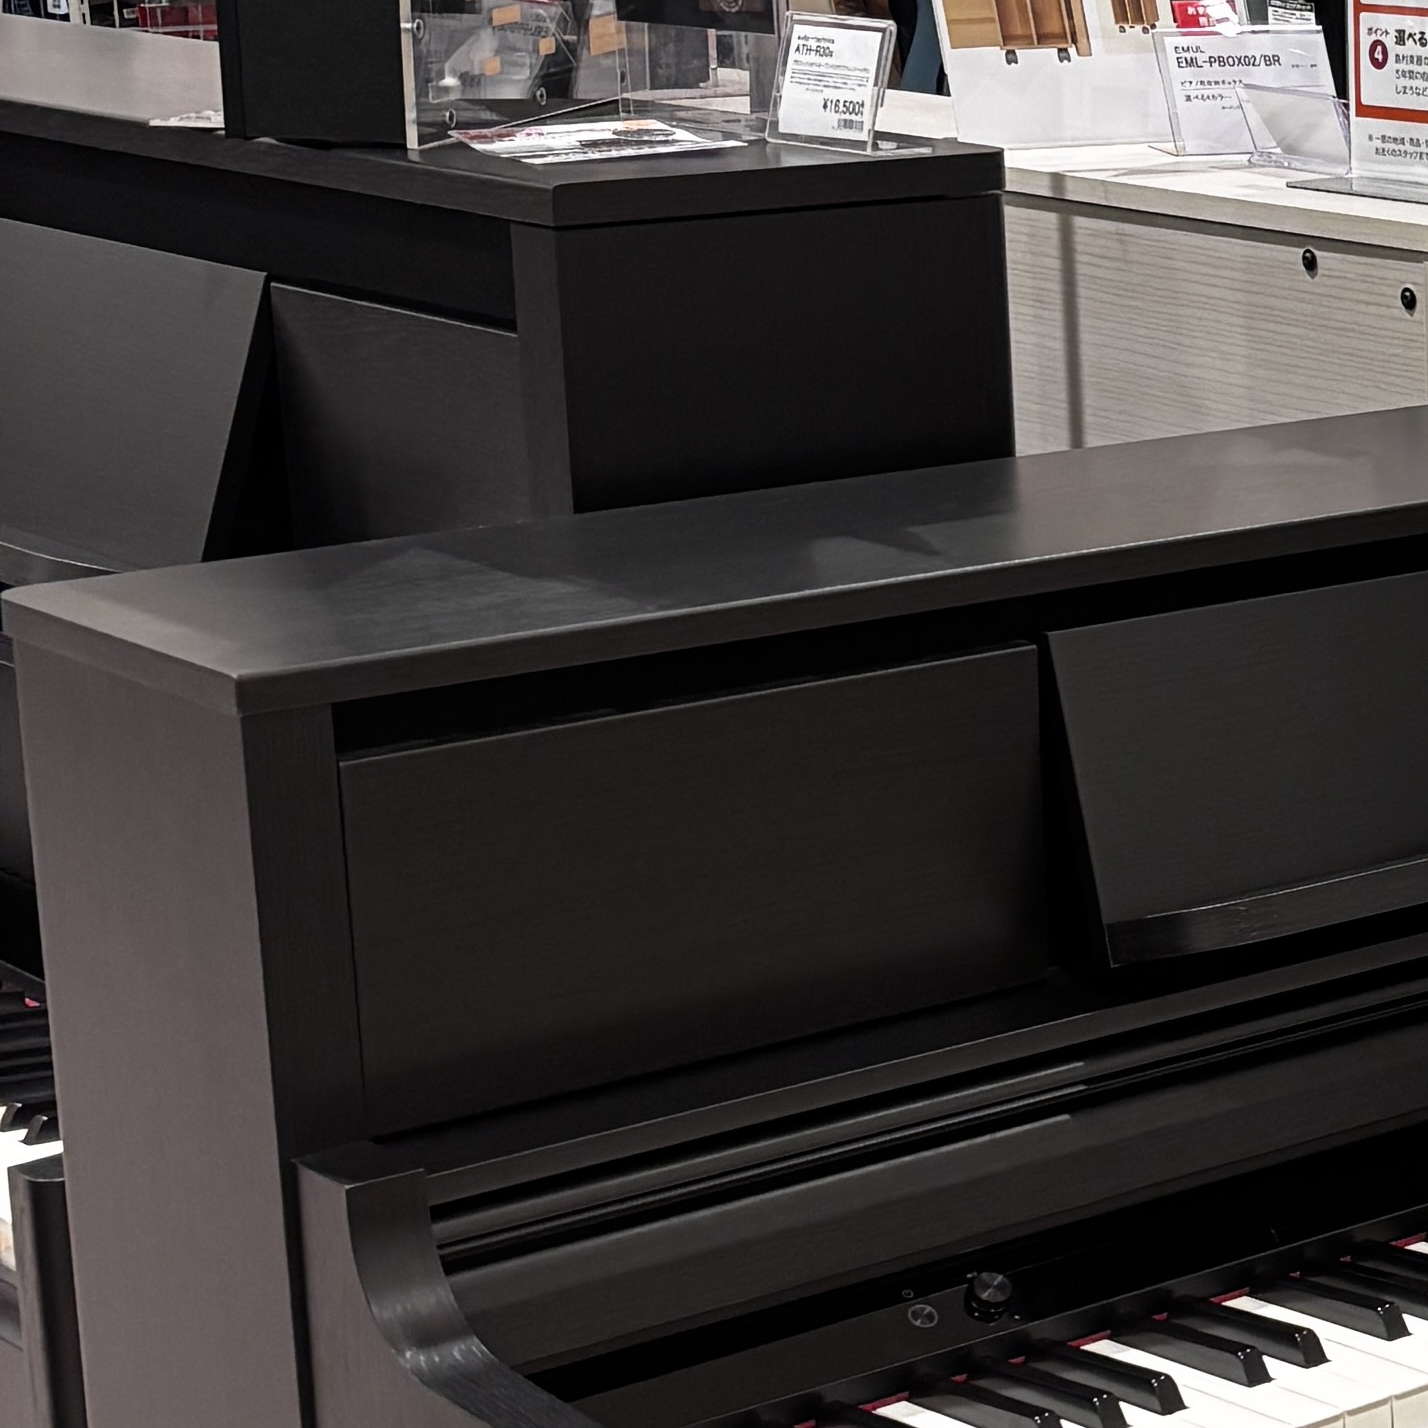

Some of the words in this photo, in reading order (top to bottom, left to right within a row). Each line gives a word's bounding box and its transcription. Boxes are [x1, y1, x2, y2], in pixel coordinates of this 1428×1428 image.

[1367, 27, 1390, 37] ポイント
[1176, 54, 1282, 70] EML-PBOX02/BR
[1373, 44, 1383, 64] 4
